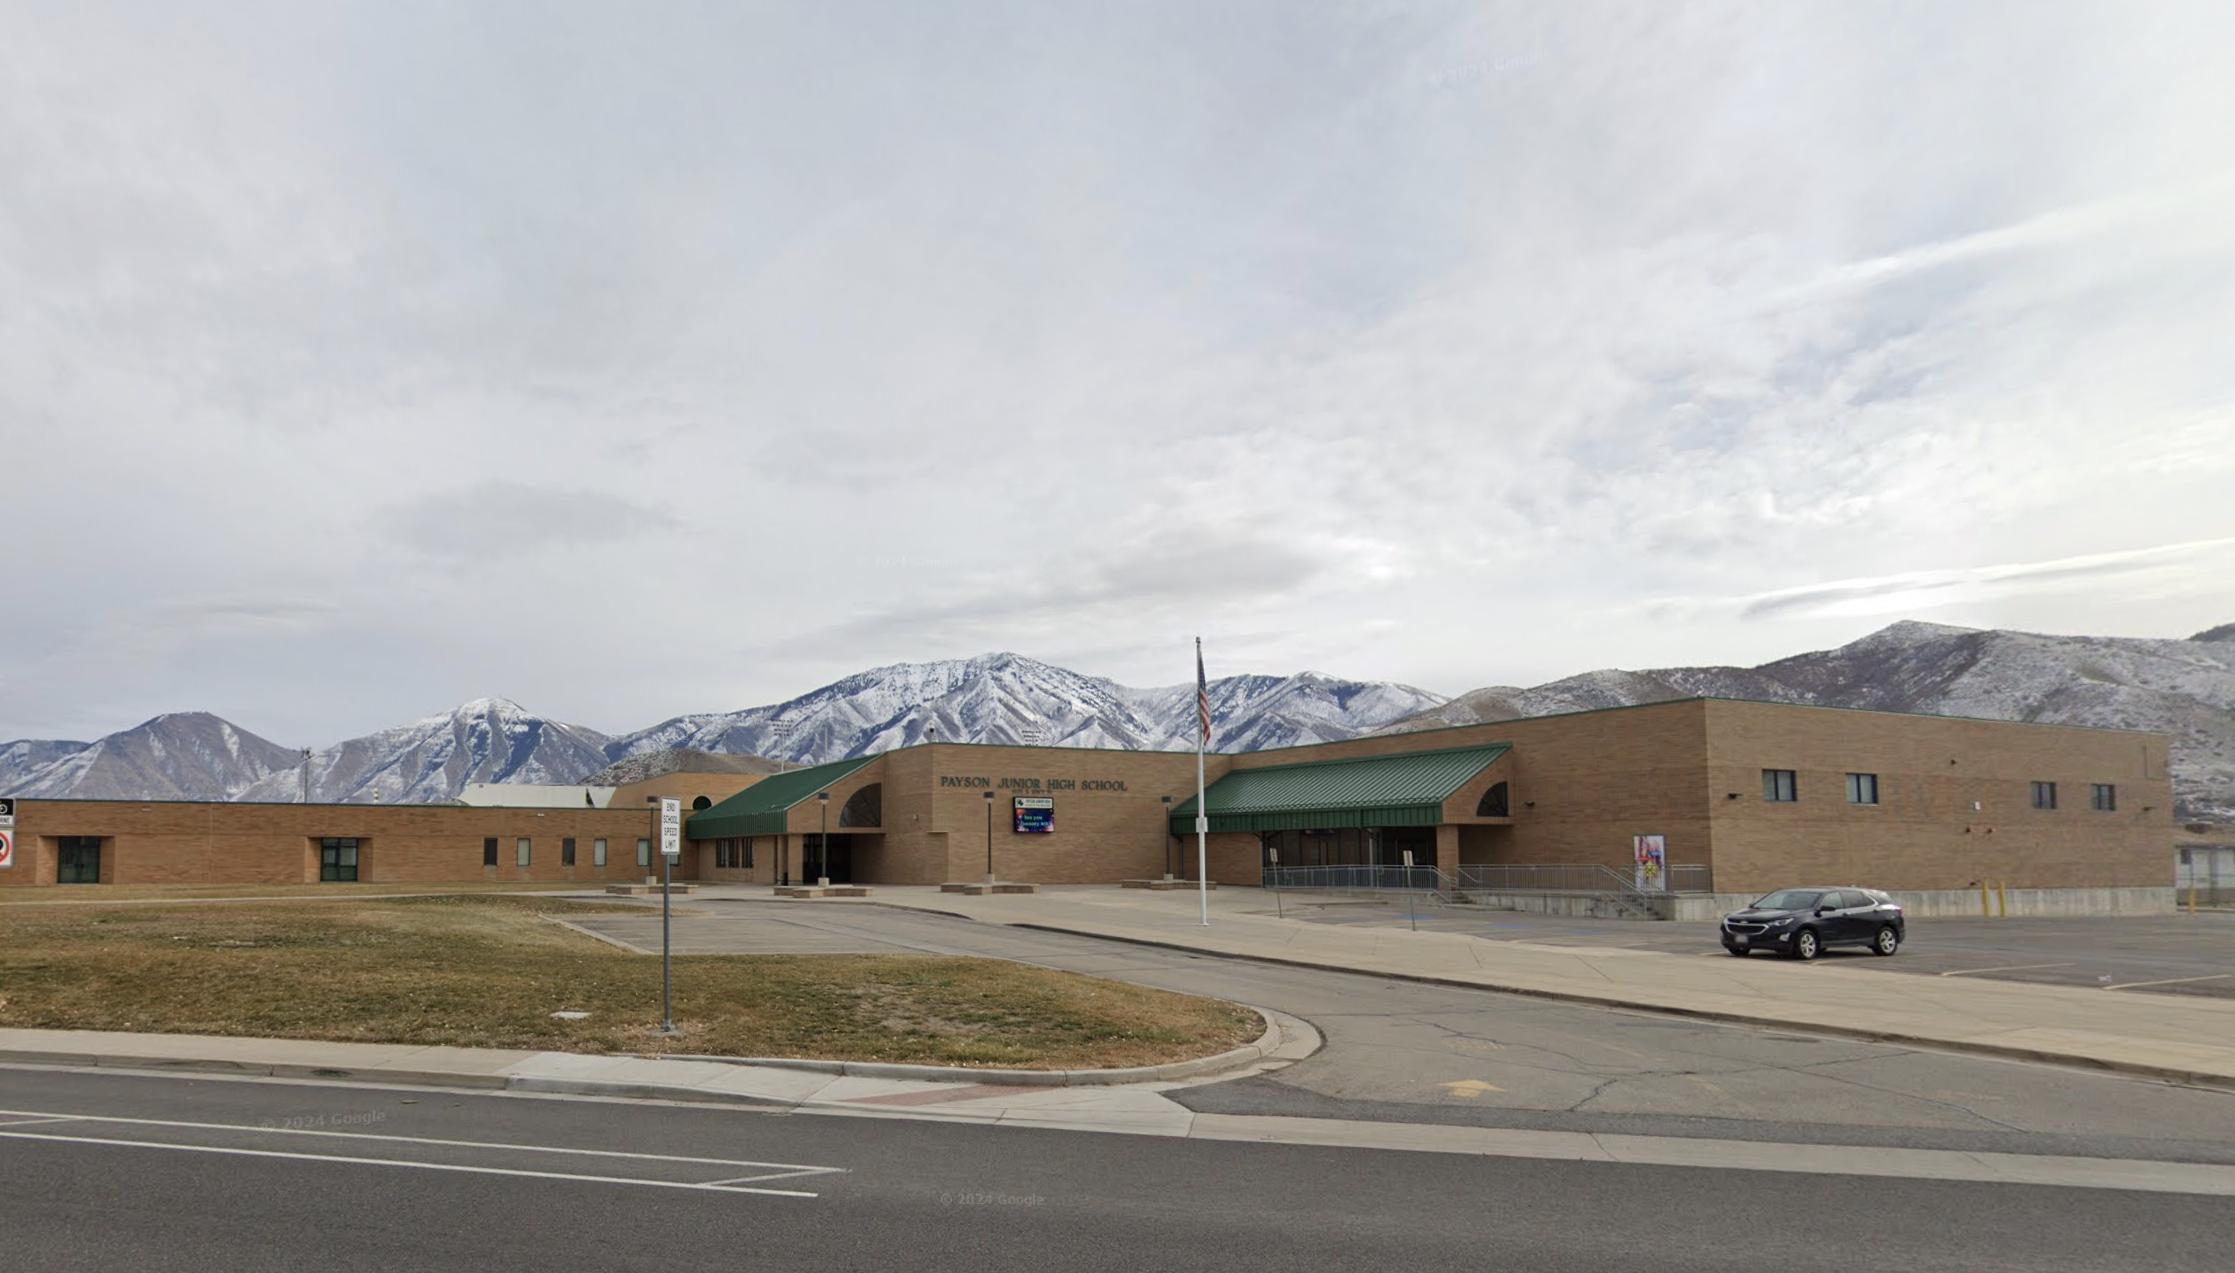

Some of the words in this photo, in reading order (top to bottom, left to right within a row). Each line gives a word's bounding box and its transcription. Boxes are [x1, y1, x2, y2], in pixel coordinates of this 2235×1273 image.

[940, 775, 991, 788] PAYSON
[997, 776, 1040, 789] JUNIOR
[1047, 778, 1076, 791] HIGH
[1081, 780, 1128, 792] SCHOOL
[663, 814, 679, 824] SCHOOL
[664, 827, 677, 836] SPEED
[665, 839, 676, 849] LIMIT
